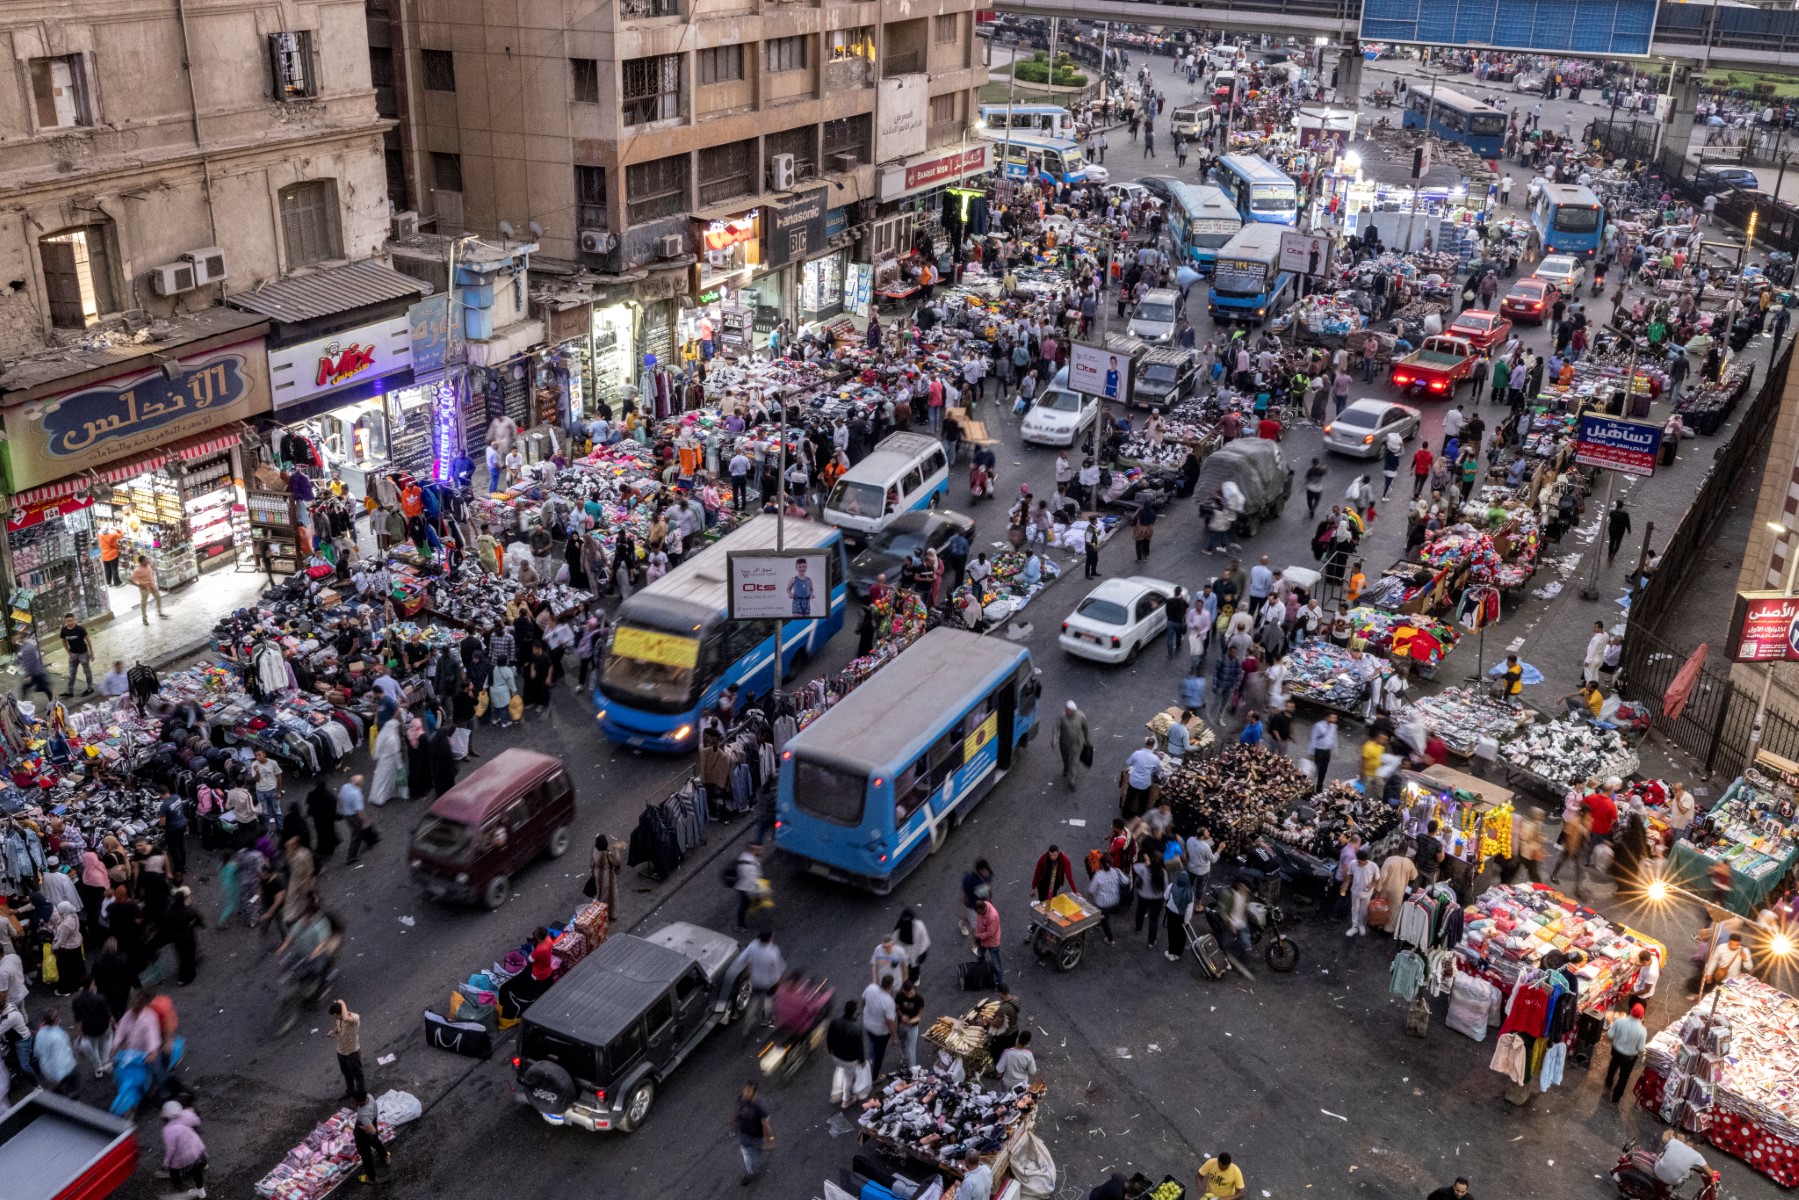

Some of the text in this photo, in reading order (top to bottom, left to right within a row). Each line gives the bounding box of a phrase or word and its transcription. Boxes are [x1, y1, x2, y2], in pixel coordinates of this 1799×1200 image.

[917, 164, 949, 180] BANQUE MISR
[776, 205, 820, 229] Panasonic
[790, 231, 806, 253] BTC
[316, 342, 376, 386] Mix
[1076, 363, 1097, 374] Ots
[1586, 425, 1653, 445] تساهيل
[742, 583, 777, 592] Ots
